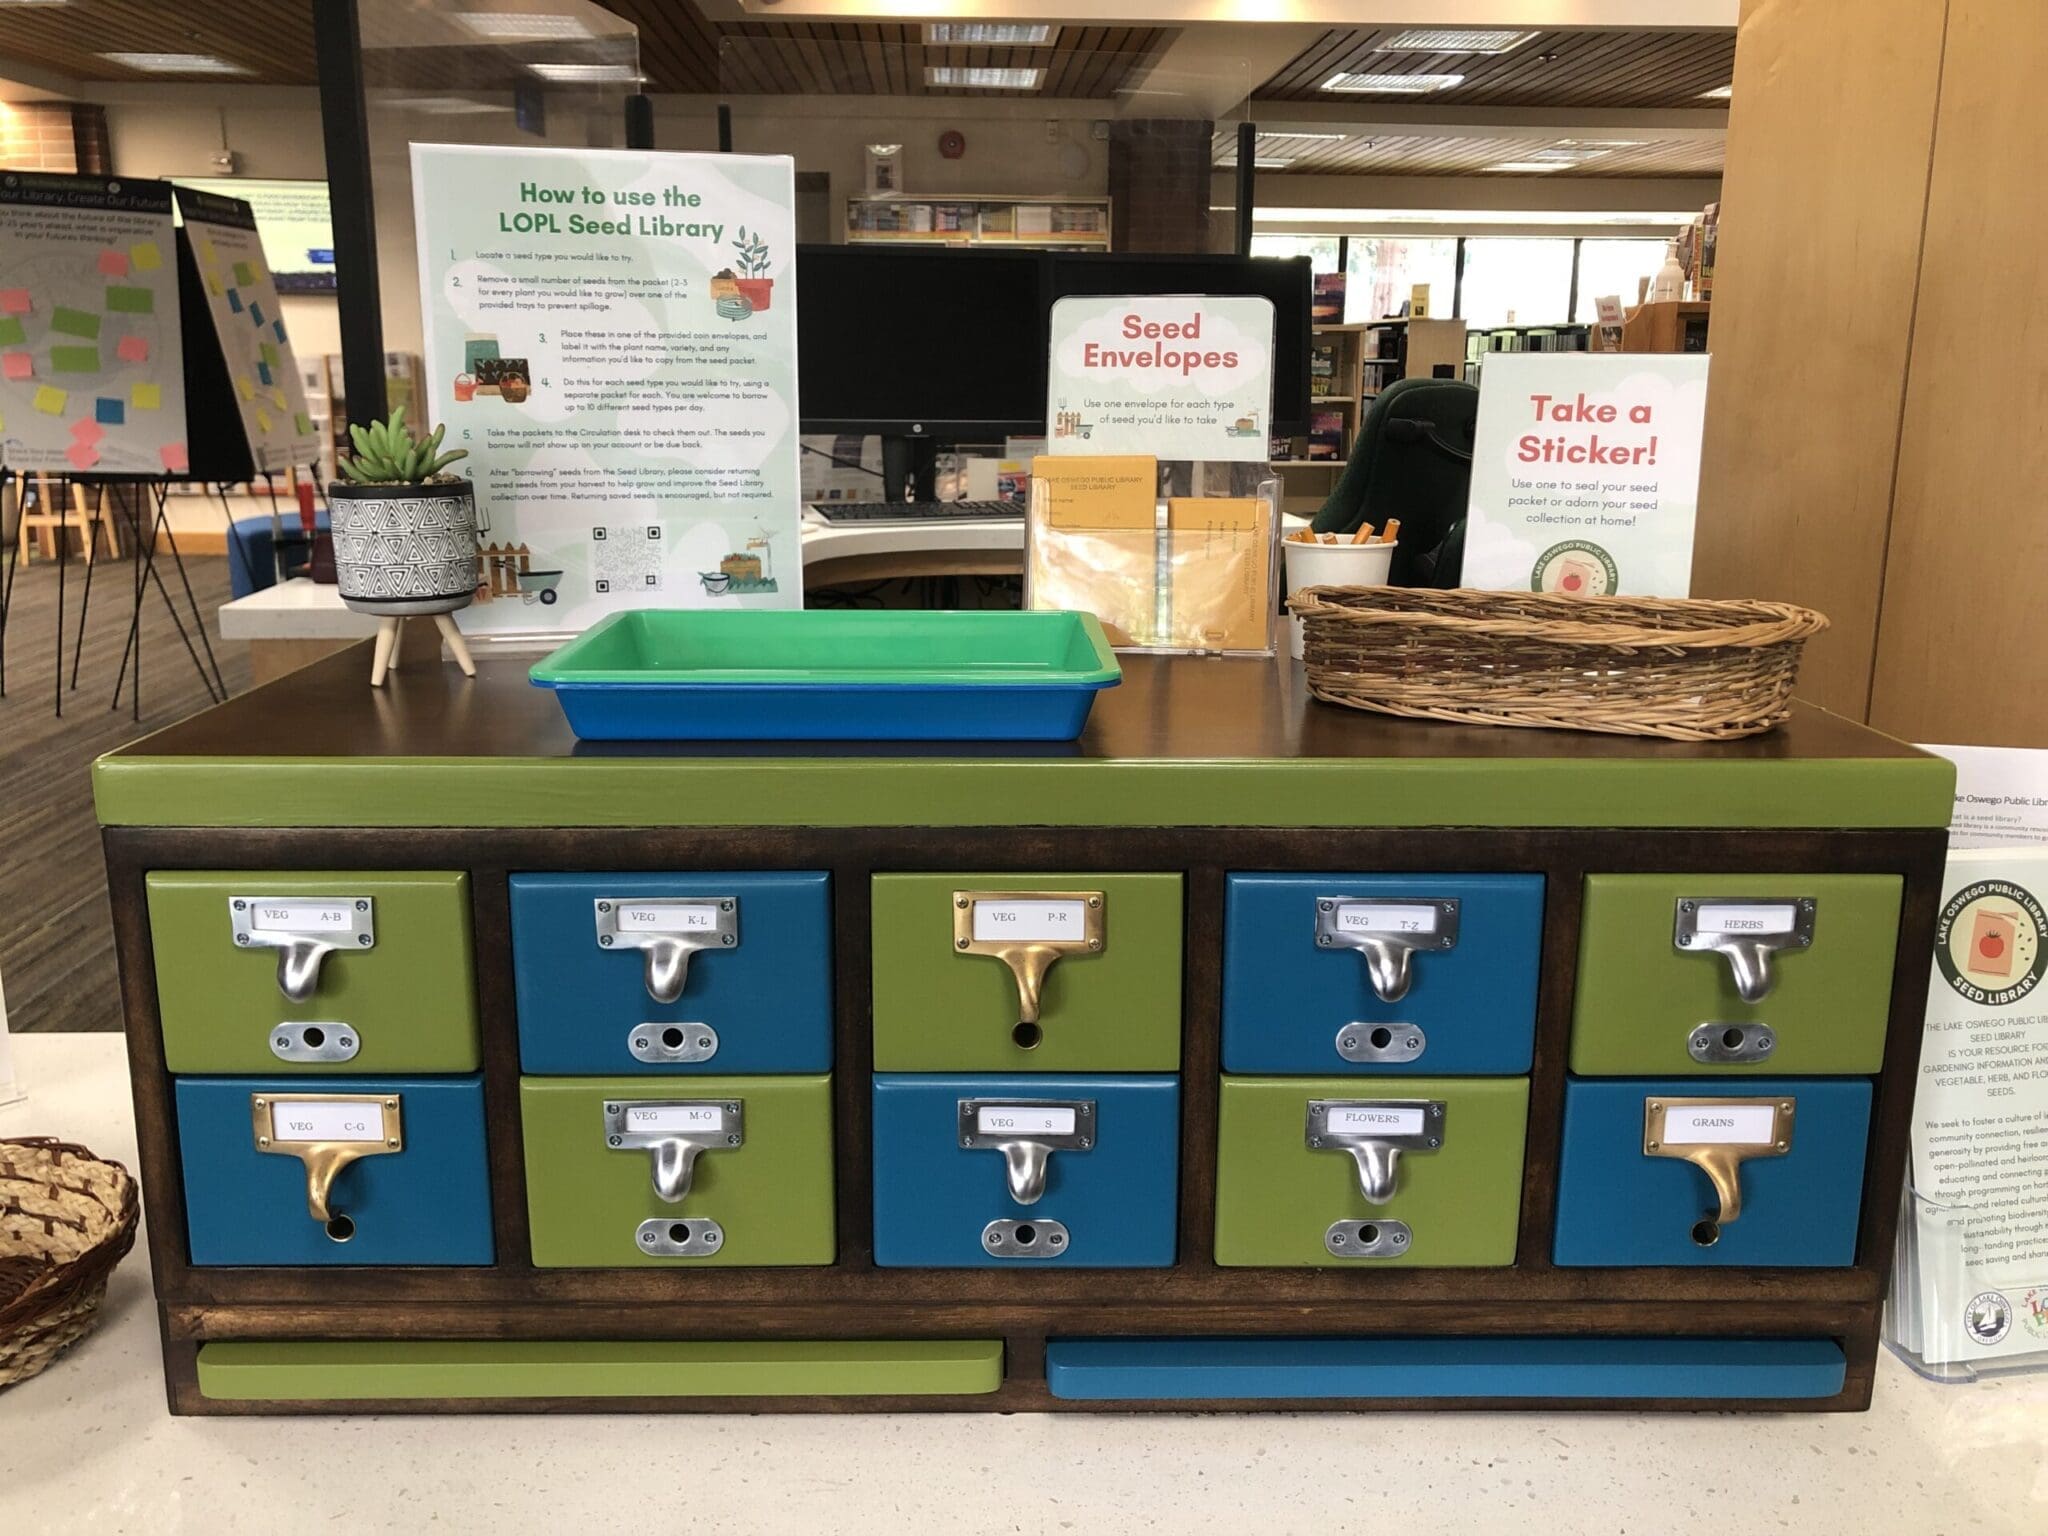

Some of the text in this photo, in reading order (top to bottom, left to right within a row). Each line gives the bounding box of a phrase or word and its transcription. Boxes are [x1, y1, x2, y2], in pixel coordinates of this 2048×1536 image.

[520, 182, 700, 207] How to use the
[499, 212, 723, 243] LOPL Seed Library
[1122, 313, 1201, 339] Seed
[1084, 341, 1239, 376] Envelopes
[1083, 398, 1101, 408] Use
[1124, 398, 1167, 410] envelope
[1170, 398, 1184, 408] for
[1186, 398, 1210, 408] each
[1213, 400, 1234, 411] type
[1530, 394, 1651, 423] Take a
[1099, 413, 1217, 426] of seed you'd like to take
[1517, 435, 1658, 466] Sticker!
[1511, 478, 1658, 494] Use one to seal your seed
[1508, 495, 1547, 507] packet
[1564, 496, 1599, 507] adorn
[1601, 501, 1627, 511] your
[1629, 499, 1658, 510] seed
[1526, 512, 1635, 526] collection at home!
[1535, 542, 1616, 582] LAKE OSWEGO PUBLIC LIBRARY
[1966, 794, 2002, 806] Oswego
[2004, 796, 2030, 805] Public
[264, 910, 342, 921] VEG A-B
[631, 912, 708, 925] VEG K-L
[992, 912, 1067, 922] VEG P-R
[1938, 883, 2048, 945] LAKE OSWEGO PUBLIC LIBRARY
[1345, 916, 1420, 930] VEG T-Z
[1723, 919, 1764, 929] HERBS
[1953, 970, 2038, 1004] SEED LIBRARY
[1926, 1016, 2036, 1032] THE LAKE OSWEGO PUBLIC
[1970, 1031, 2026, 1043] SEED LIBRARY
[1948, 1044, 2030, 1058] IS YOUR RESOURCE
[1923, 1058, 2033, 1074] GARDENING INFORMATION
[1935, 1072, 2030, 1087] VEGETABLE, HERB, AND
[1987, 1087, 2016, 1097] SEEDS.
[633, 1110, 712, 1121] VEG M-O
[990, 1117, 1052, 1128] VEG S
[1345, 1112, 1401, 1124] FLOWERS
[1692, 1117, 1735, 1127] GRAINS
[1925, 1121, 1938, 1129] We
[1941, 1119, 1960, 1128] seek
[1962, 1119, 1970, 1127] to
[1973, 1117, 1996, 1126] foster
[2005, 1114, 2032, 1123] culture
[2034, 1112, 2042, 1120] of
[289, 1121, 366, 1132] VEG C-G
[1939, 1168, 2042, 1185] educating and connecting
